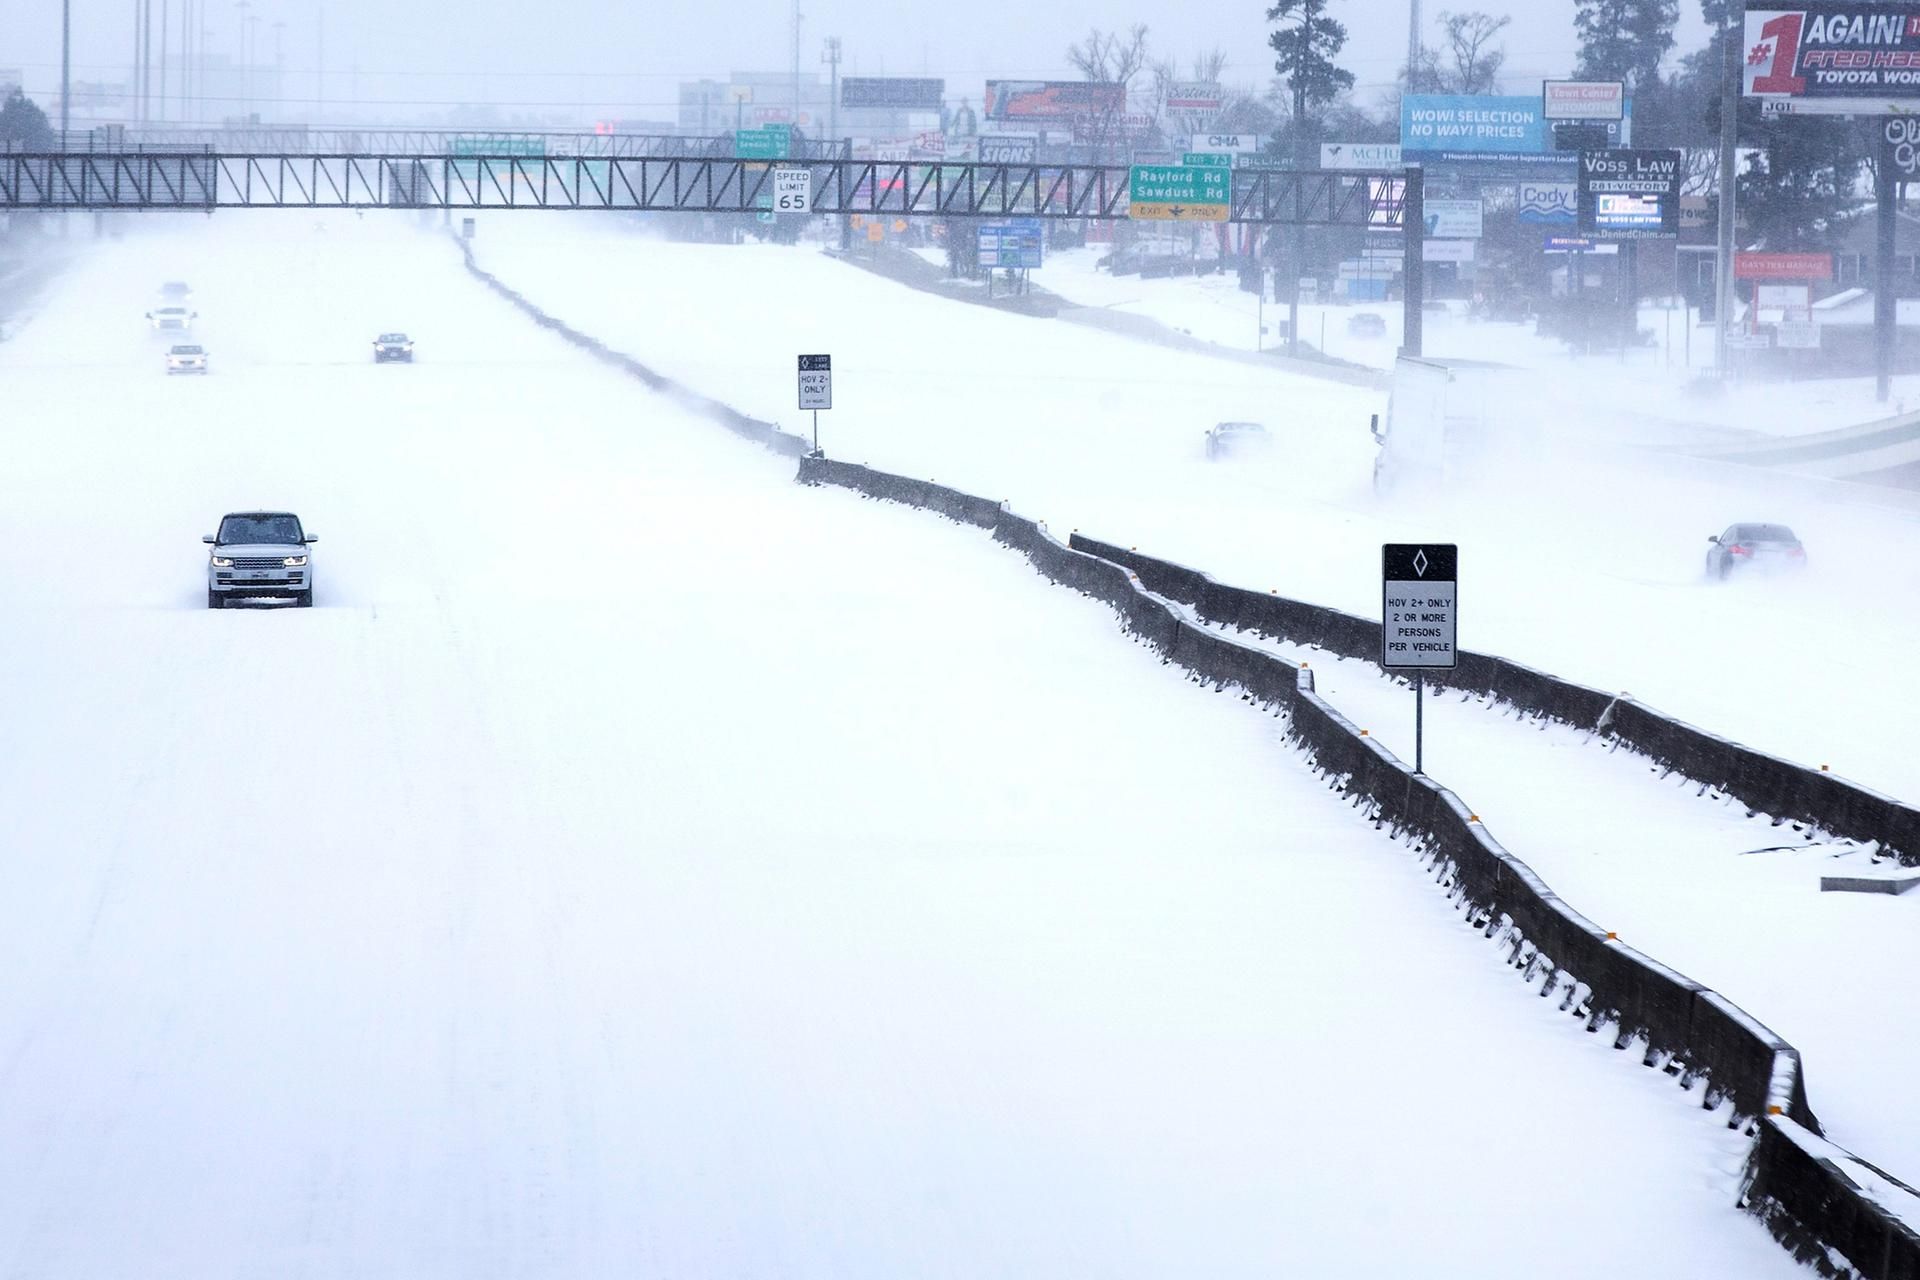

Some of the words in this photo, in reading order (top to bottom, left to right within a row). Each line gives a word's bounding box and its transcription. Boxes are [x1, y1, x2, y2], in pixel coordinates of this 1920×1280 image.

[1805, 14, 1906, 45] AGAIN!
[1747, 13, 1807, 93] #1
[1816, 71, 1878, 83] TOYOTA
[1552, 87, 1579, 98] Town
[1581, 87, 1614, 98] Center
[1411, 110, 1454, 122] WOW!
[1457, 110, 1534, 123] SELECTION
[1411, 124, 1432, 136] NO
[1436, 124, 1473, 137] WAY!
[1477, 126, 1525, 138] PRICES
[981, 147, 1033, 163] SIGNS
[1213, 155, 1228, 165] 73
[1448, 153, 1478, 161] Houston
[1520, 155, 1556, 163] Superstore
[776, 172, 809, 181] SPEED
[1139, 171, 1193, 183] Rayford
[1204, 172, 1221, 183] Rd
[779, 183, 804, 191] LIMIT
[1137, 186, 1195, 197] Sawdust
[1206, 187, 1223, 198] Rd
[1524, 187, 1568, 205] Cody
[779, 195, 804, 209] 65
[1191, 207, 1219, 216] ONLY
[801, 375, 817, 383] HOV
[804, 385, 826, 394] ONLY
[1388, 598, 1407, 608] HOV
[1411, 598, 1424, 608] 2+
[1428, 598, 1452, 608] ONLY
[1393, 613, 1400, 622] 2
[1404, 613, 1417, 622] OR
[1421, 613, 1447, 623] MORE
[1398, 627, 1442, 638] PERSONS
[1388, 642, 1407, 652] PER
[1413, 642, 1450, 652] VEHICLE
